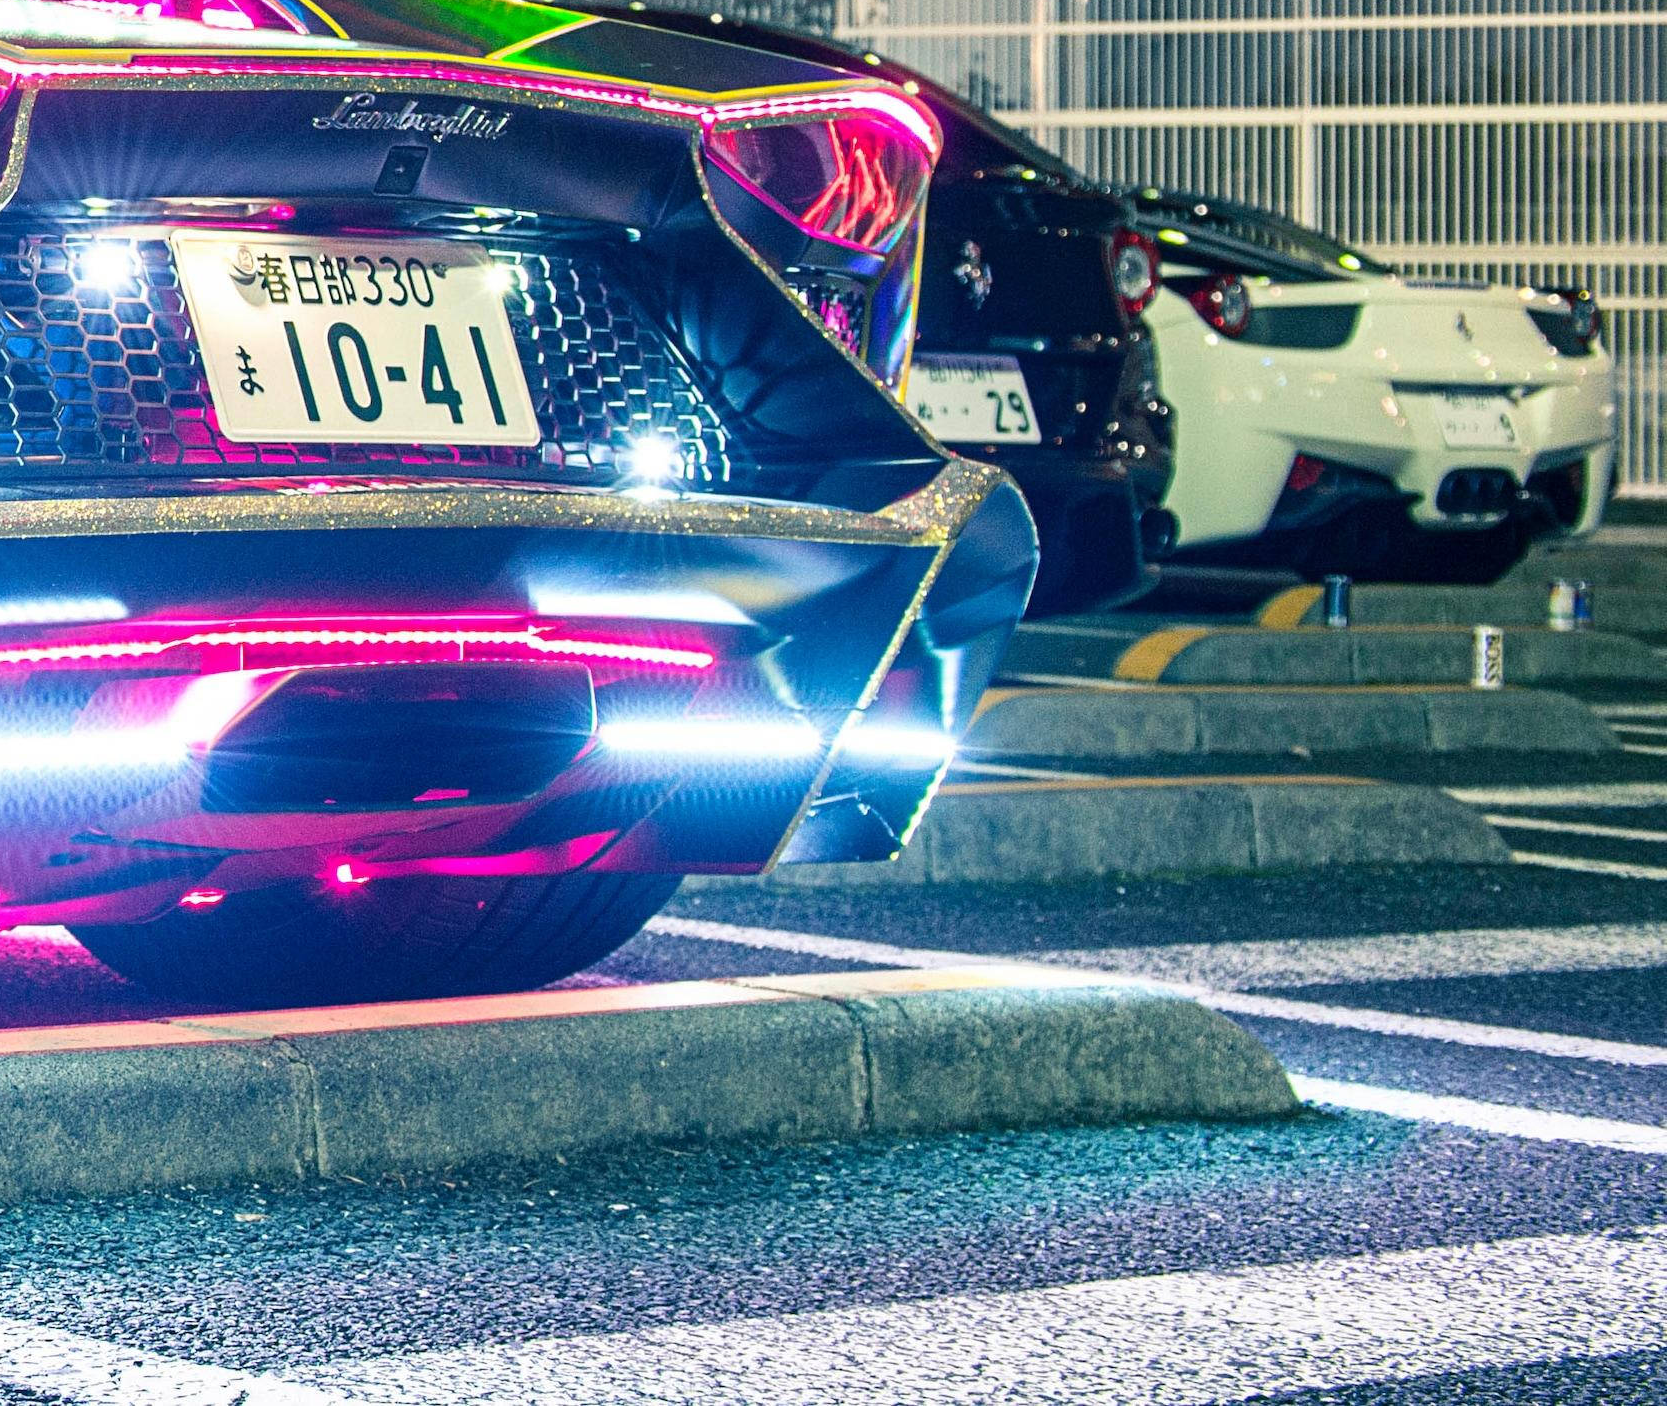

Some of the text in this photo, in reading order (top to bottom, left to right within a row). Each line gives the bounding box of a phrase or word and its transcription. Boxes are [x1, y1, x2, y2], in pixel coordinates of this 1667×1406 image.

[312, 93, 513, 143] Lamborghini
[235, 321, 507, 426] ま 10-41
